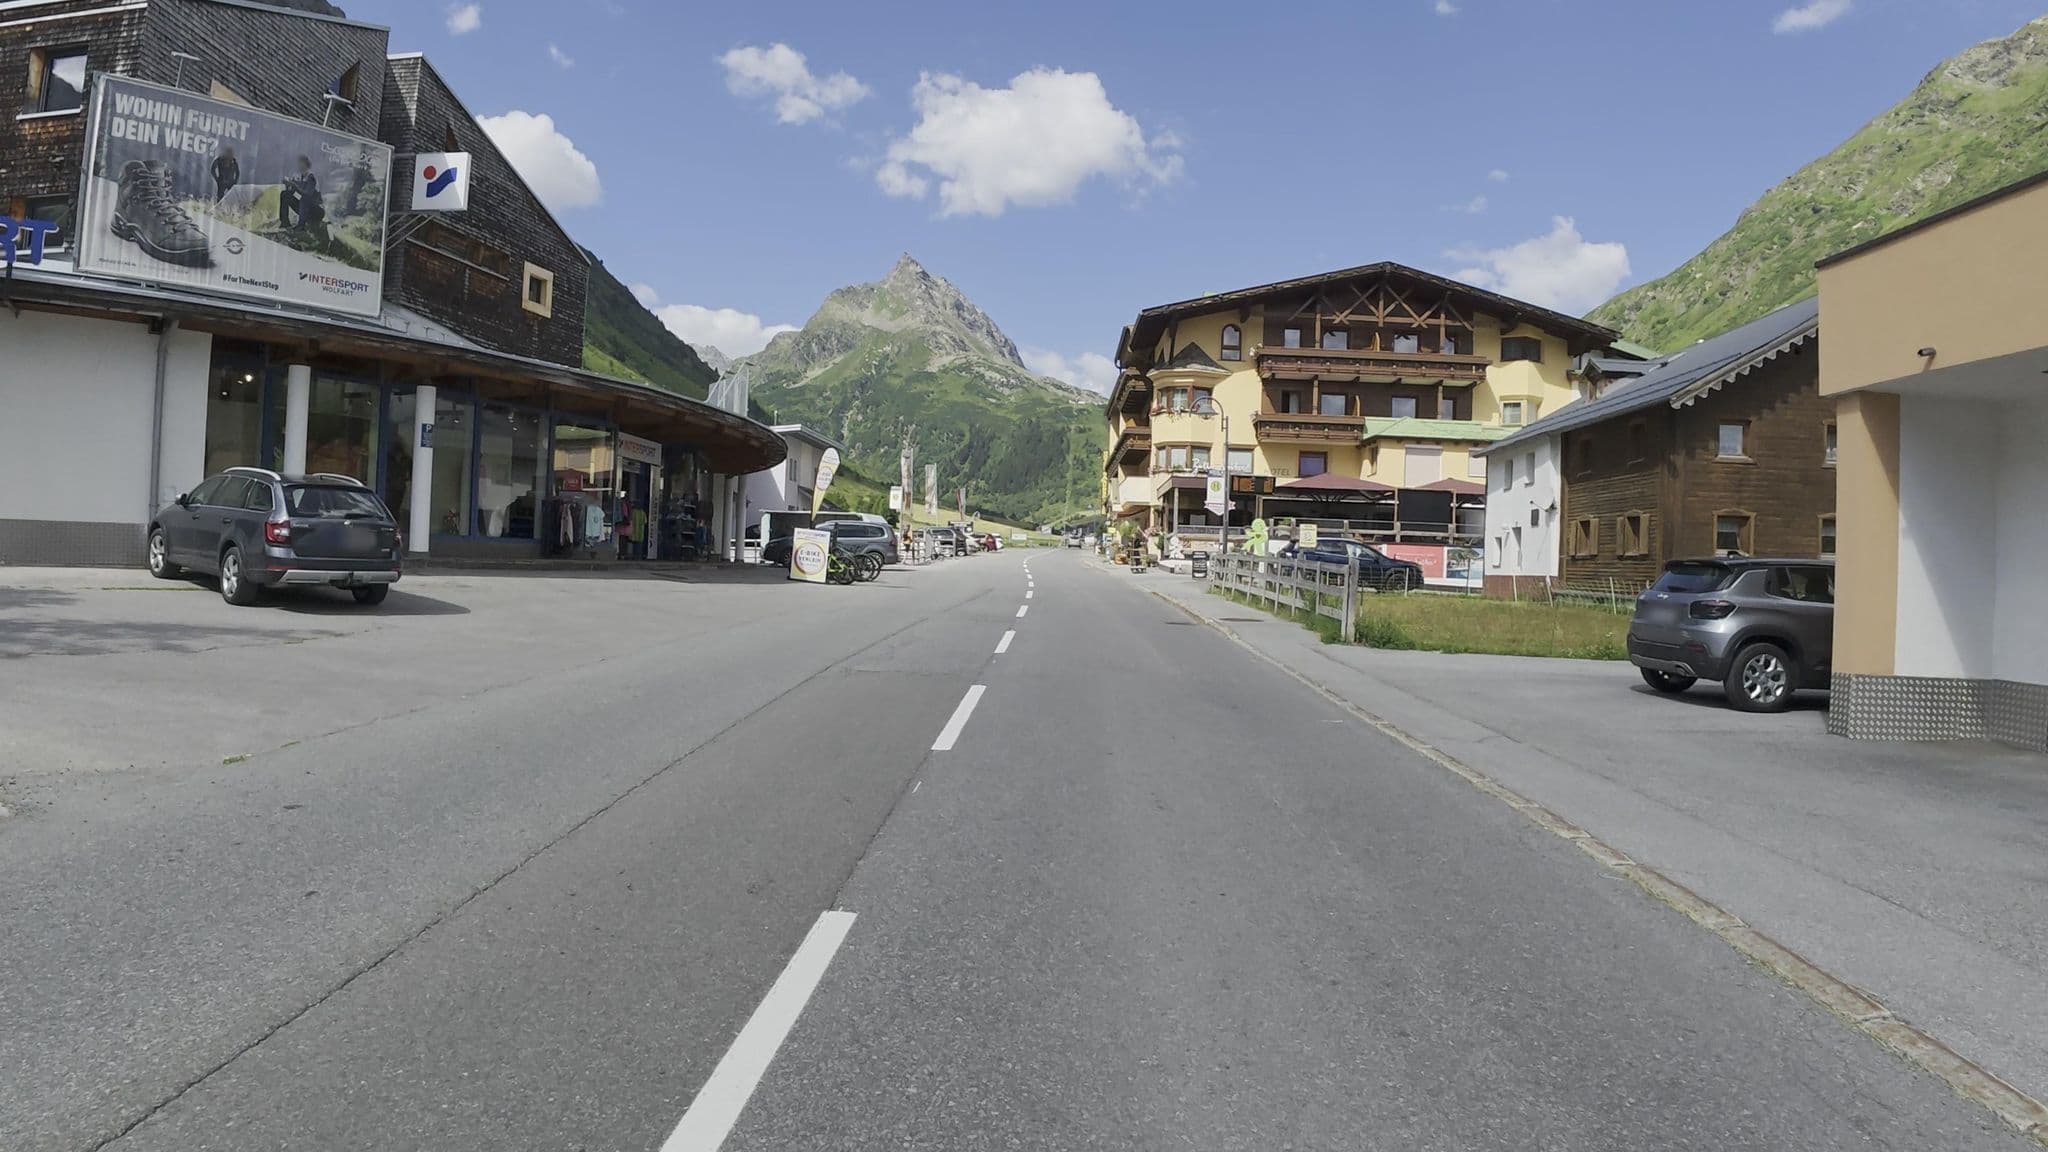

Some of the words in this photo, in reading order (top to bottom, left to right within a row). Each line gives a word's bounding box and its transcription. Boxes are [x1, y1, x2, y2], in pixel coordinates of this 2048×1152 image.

[115, 92, 183, 126] WOHIN
[186, 108, 250, 141] FÜHRT
[111, 116, 160, 145] DEIN
[164, 126, 219, 157] WEG?
[222, 273, 280, 291] #ForTheNextStep
[308, 273, 370, 293] INTERSPORT
[322, 285, 354, 297] WOLFART
